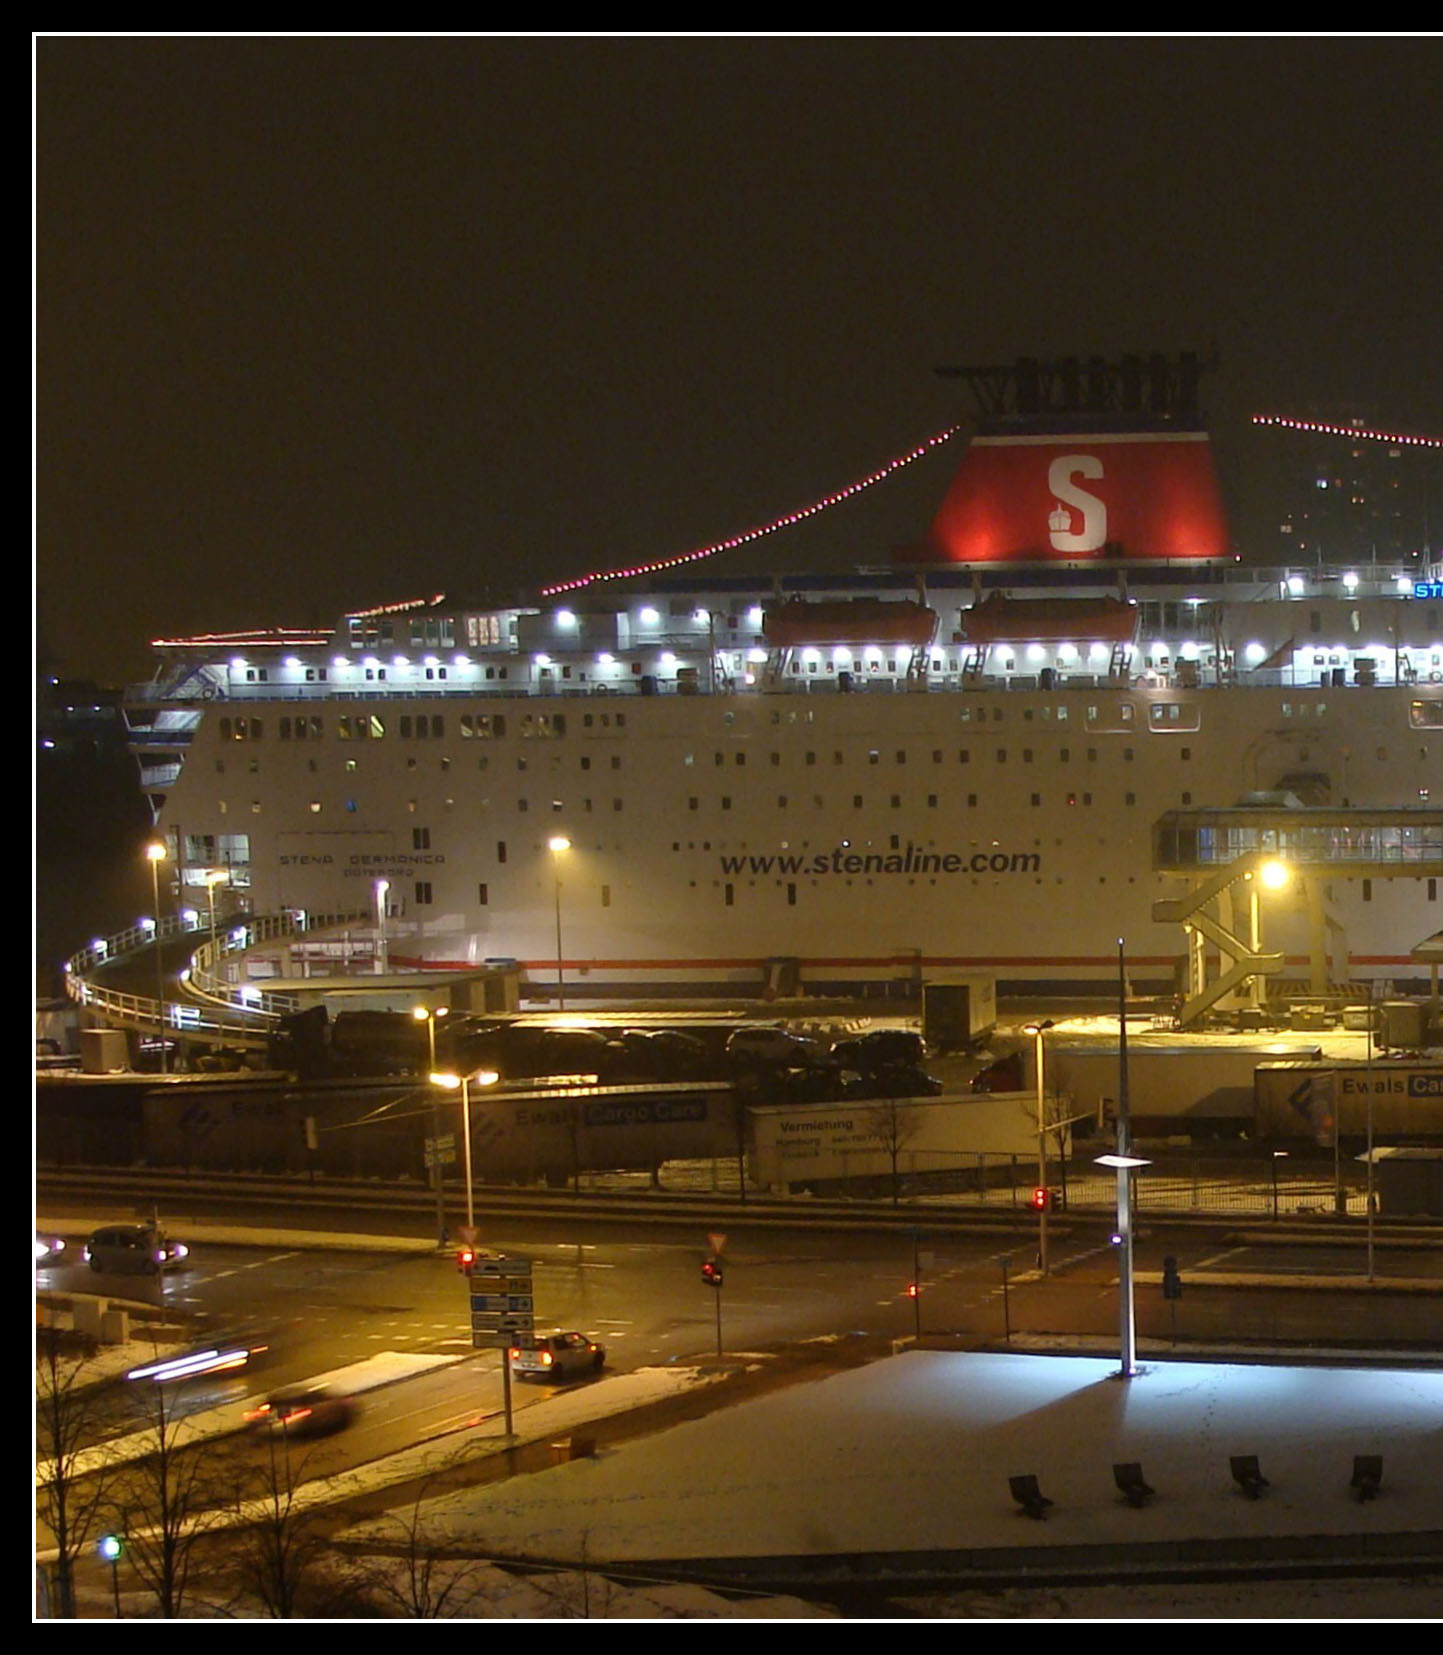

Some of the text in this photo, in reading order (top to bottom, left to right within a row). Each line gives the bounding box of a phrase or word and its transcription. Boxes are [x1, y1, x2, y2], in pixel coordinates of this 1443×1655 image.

[1048, 455, 1107, 552] S
[279, 855, 334, 865] STENA
[720, 848, 1041, 875] www.stenaline.com
[1342, 1077, 1405, 1095] Ewals
[780, 1119, 853, 1133] Vermietung
